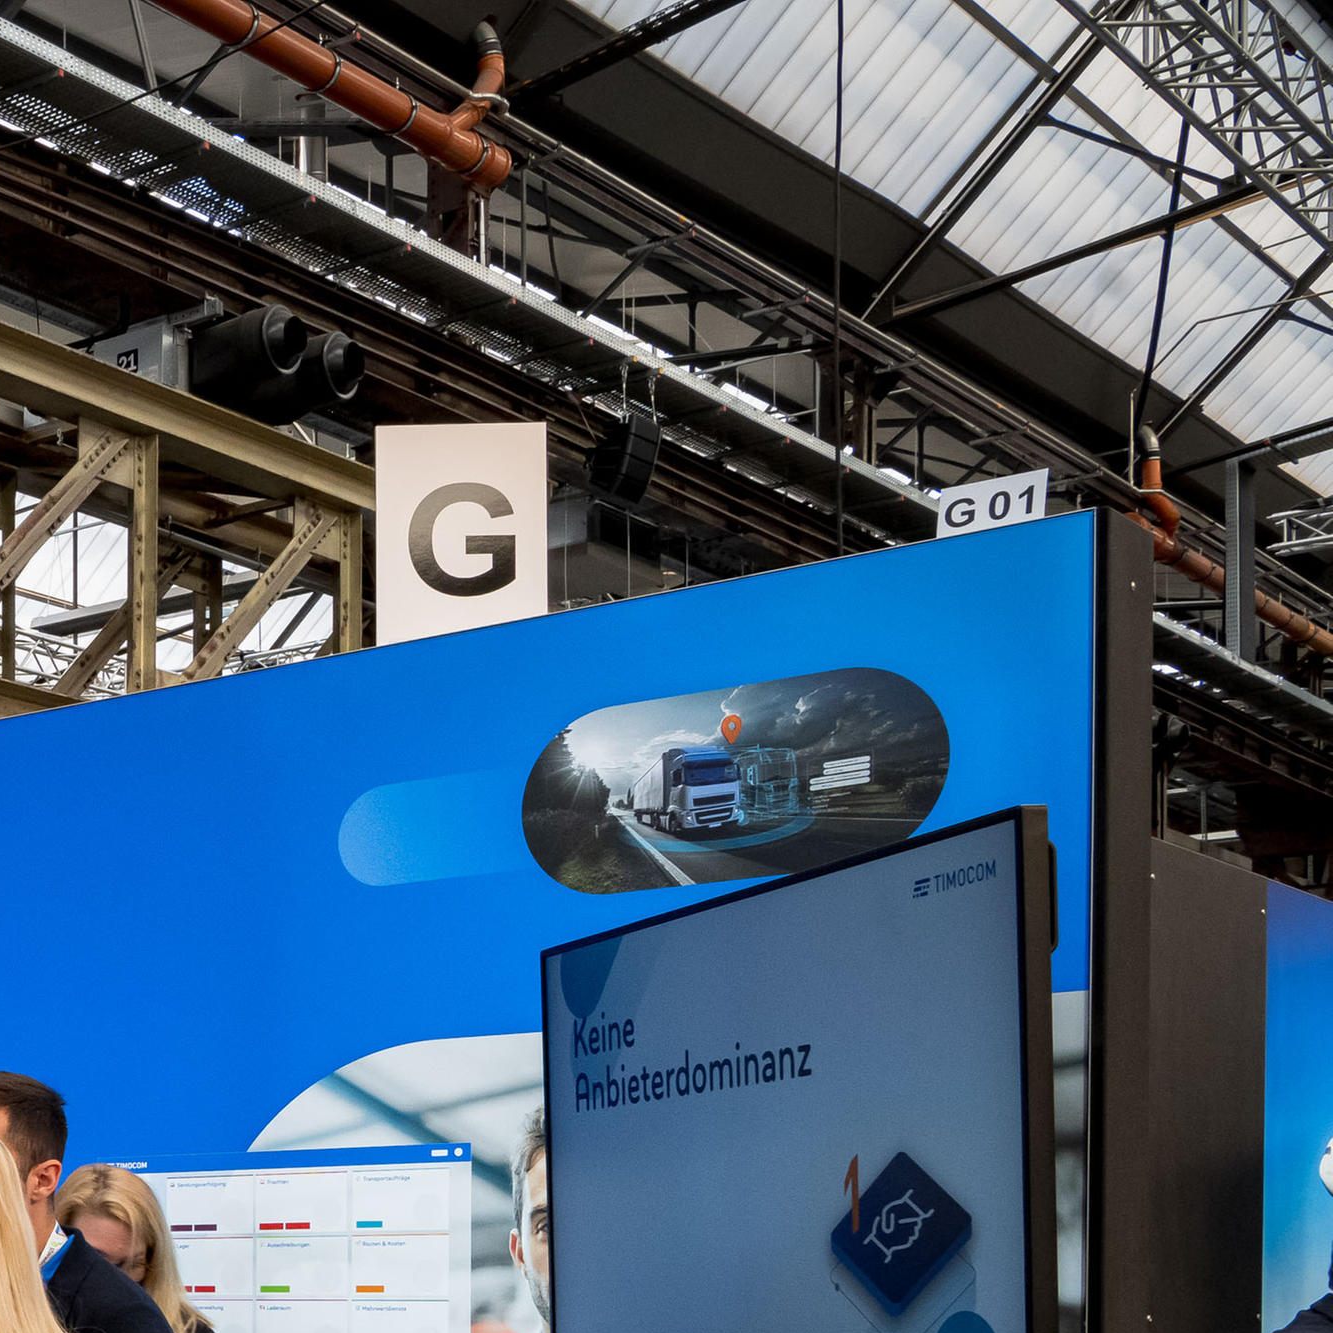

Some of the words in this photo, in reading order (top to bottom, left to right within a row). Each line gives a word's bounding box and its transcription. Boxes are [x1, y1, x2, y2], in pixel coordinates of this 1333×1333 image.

[944, 497, 976, 528] G
[988, 485, 1035, 521] 01
[408, 482, 516, 597] G
[933, 859, 997, 893] TIMOCOM
[573, 1011, 635, 1058] Keine
[575, 1041, 813, 1113] Anbieterdominanz
